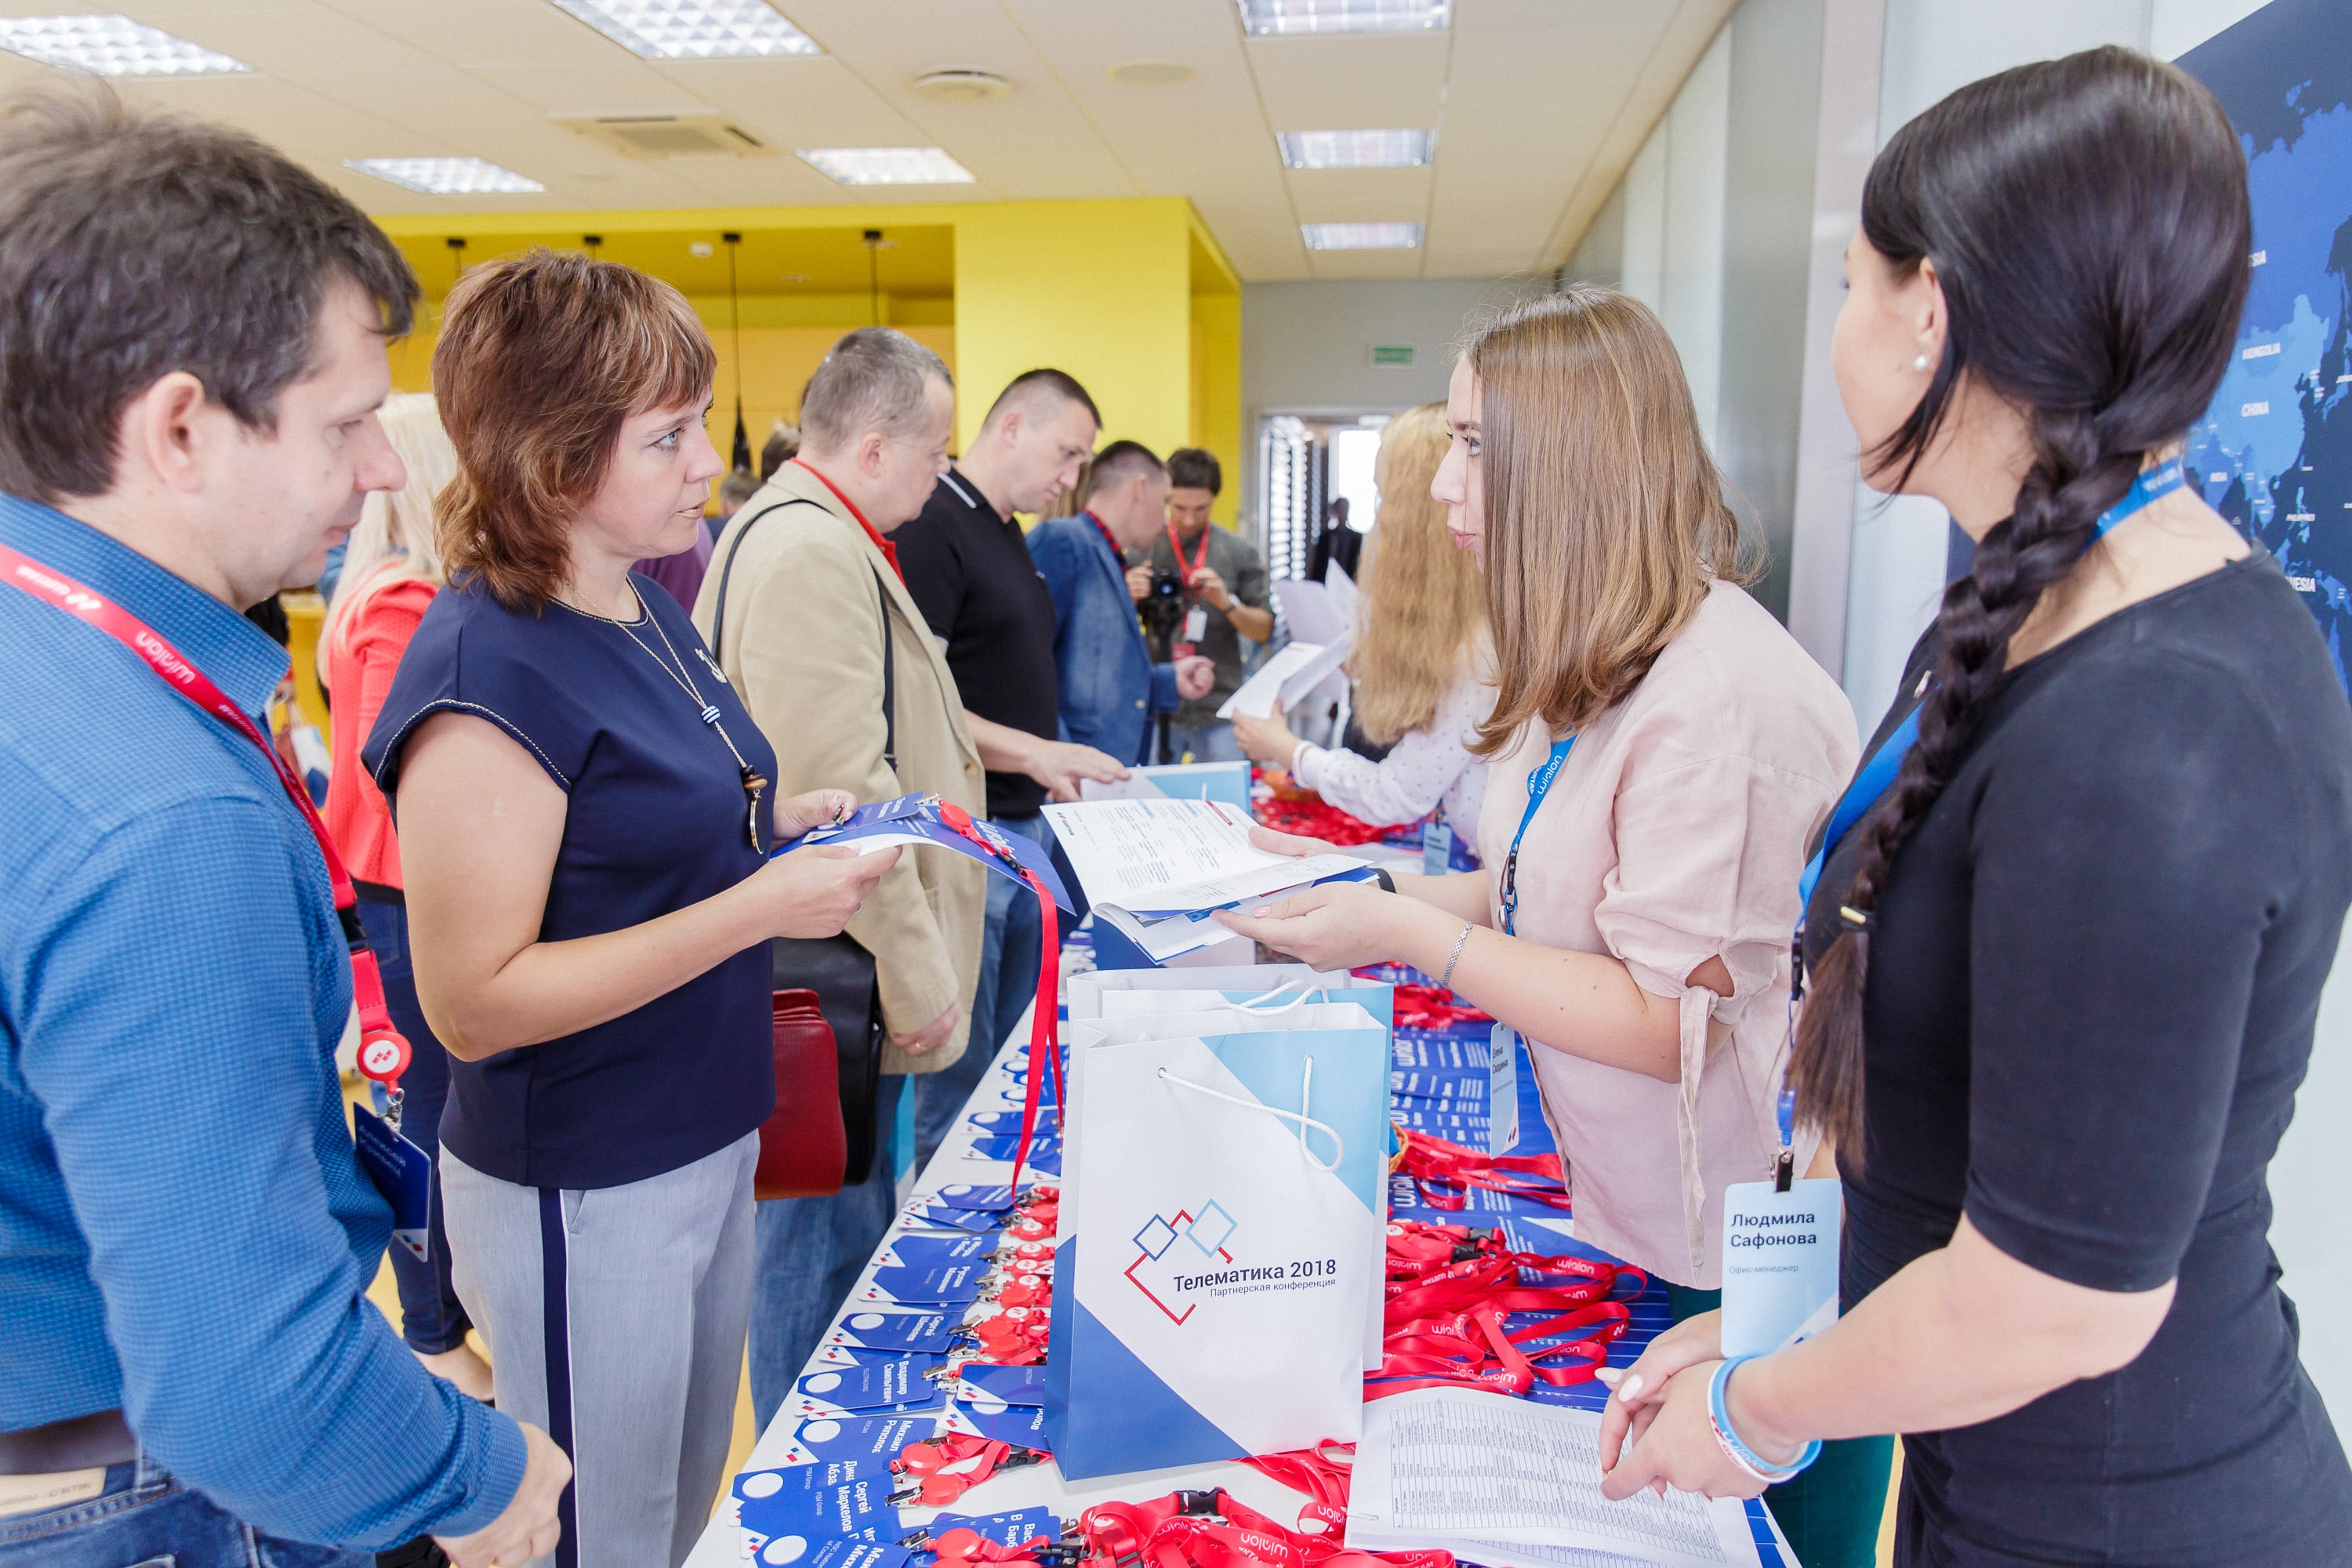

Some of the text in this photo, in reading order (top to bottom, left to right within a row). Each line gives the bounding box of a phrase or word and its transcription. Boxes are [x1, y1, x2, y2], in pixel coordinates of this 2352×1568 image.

[2241, 401, 2270, 418] CHINA
[1537, 754, 1563, 796] wialon
[1730, 1213, 1815, 1229] Людмила
[1730, 1233, 1817, 1249] Сафонова
[1174, 1259, 1337, 1293] Телематика 2018
[1210, 1278, 1337, 1298] Партнерская конференция
[883, 1363, 895, 1403] Смильгевич
[896, 1360, 909, 1395] Владимир
[889, 1420, 913, 1452] Михаил
[838, 1485, 852, 1533] Маркелов
[854, 1481, 872, 1515] Сергей
[811, 1547, 829, 1564] Control
[1240, 1532, 1288, 1559] wialon
